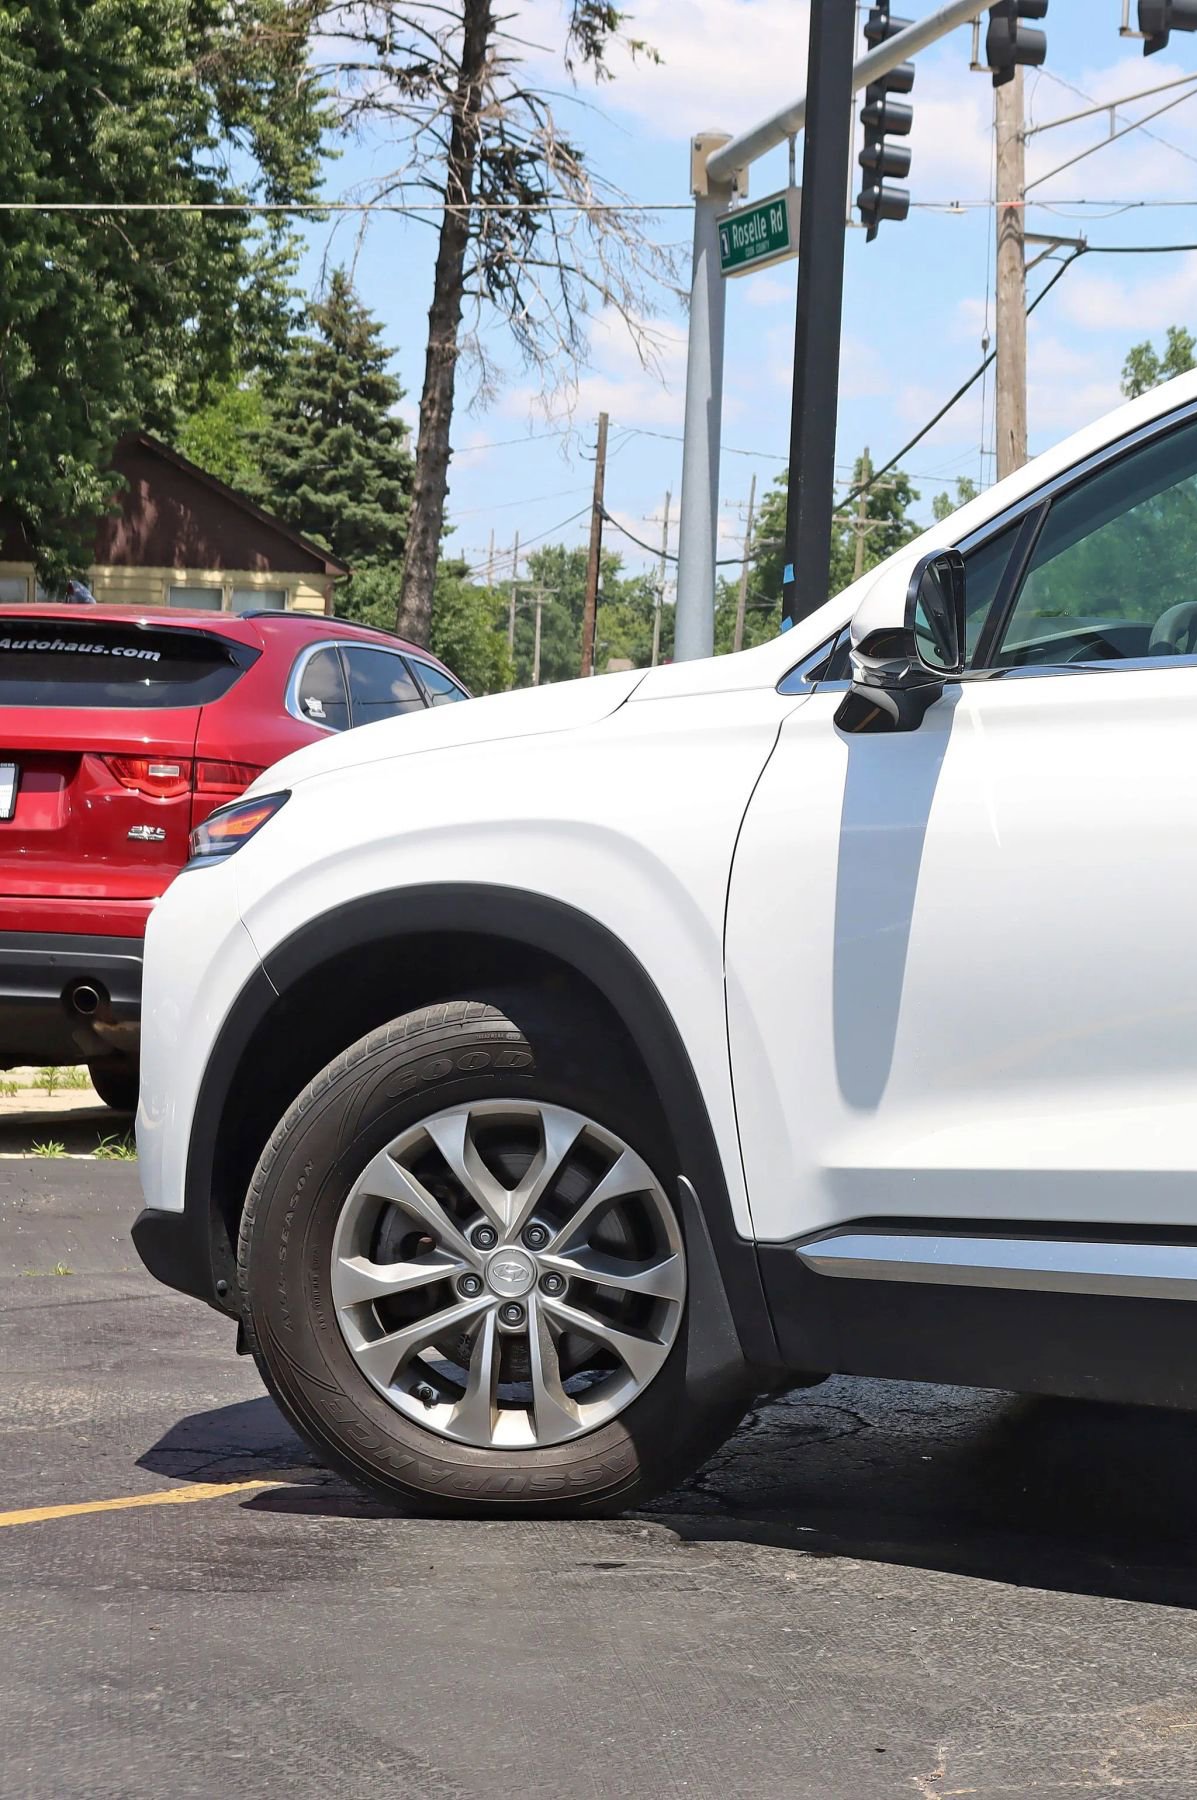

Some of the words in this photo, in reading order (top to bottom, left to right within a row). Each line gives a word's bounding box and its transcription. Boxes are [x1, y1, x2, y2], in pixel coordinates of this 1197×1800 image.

[732, 213, 767, 249] Roselle
[770, 204, 783, 235] Rd
[0, 638, 161, 661] Autohaus.com
